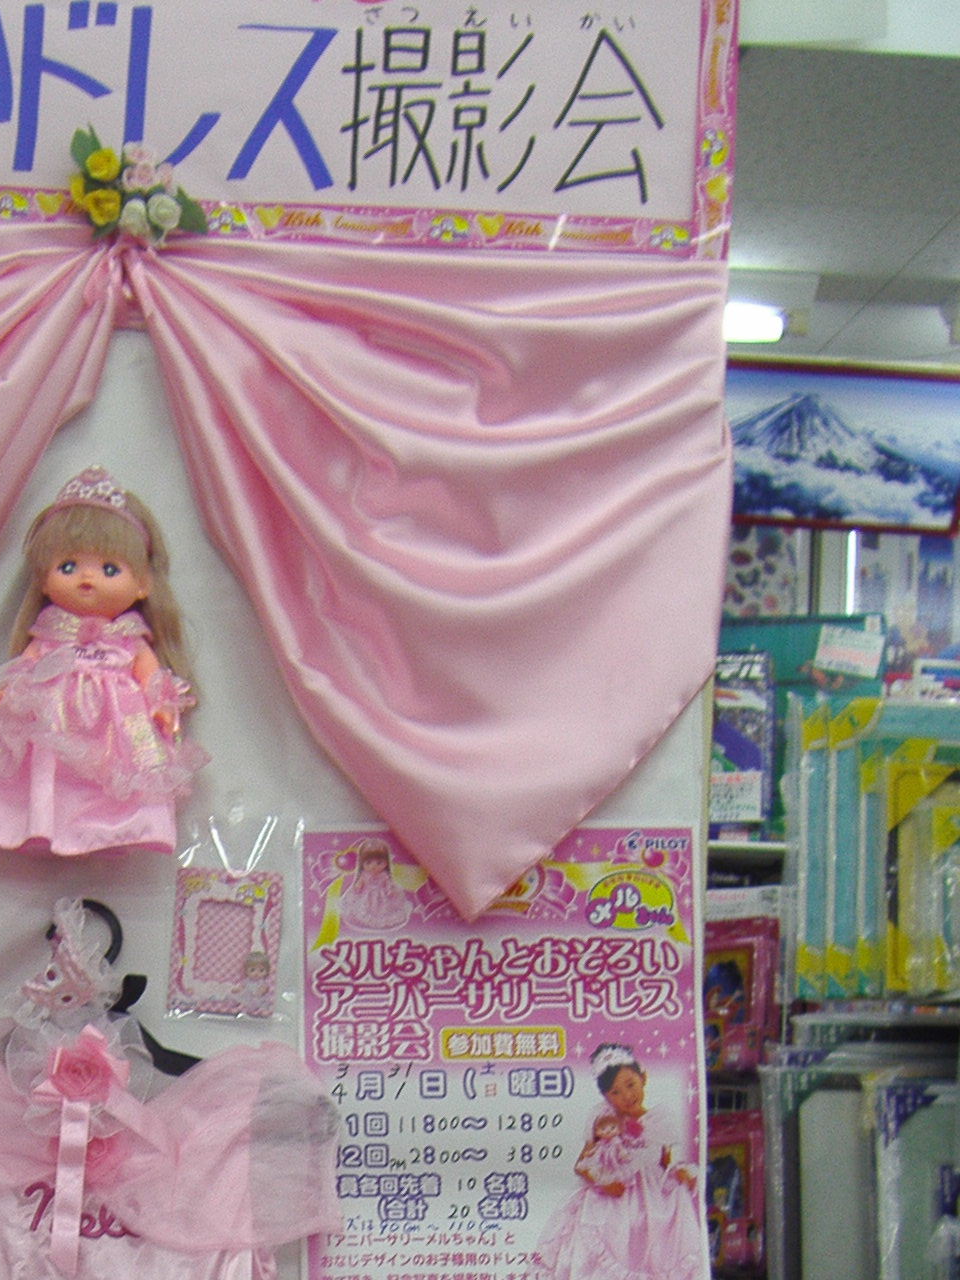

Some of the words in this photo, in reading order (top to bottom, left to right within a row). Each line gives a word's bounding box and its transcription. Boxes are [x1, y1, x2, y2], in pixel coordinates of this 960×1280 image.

[645, 838, 689, 850] PILOT
[317, 939, 683, 983] メルちゃんとおそろい
[316, 979, 683, 1021] アニバーサリードレス
[319, 1022, 431, 1061] 撮影会
[447, 1031, 561, 1057] 参加費無料
[419, 1069, 448, 1099] 日
[483, 1171, 529, 1197] 名様
[449, 1204, 472, 1219] 20
[321, 1251, 543, 1269] おなじデザインのお子様用のドレスを
